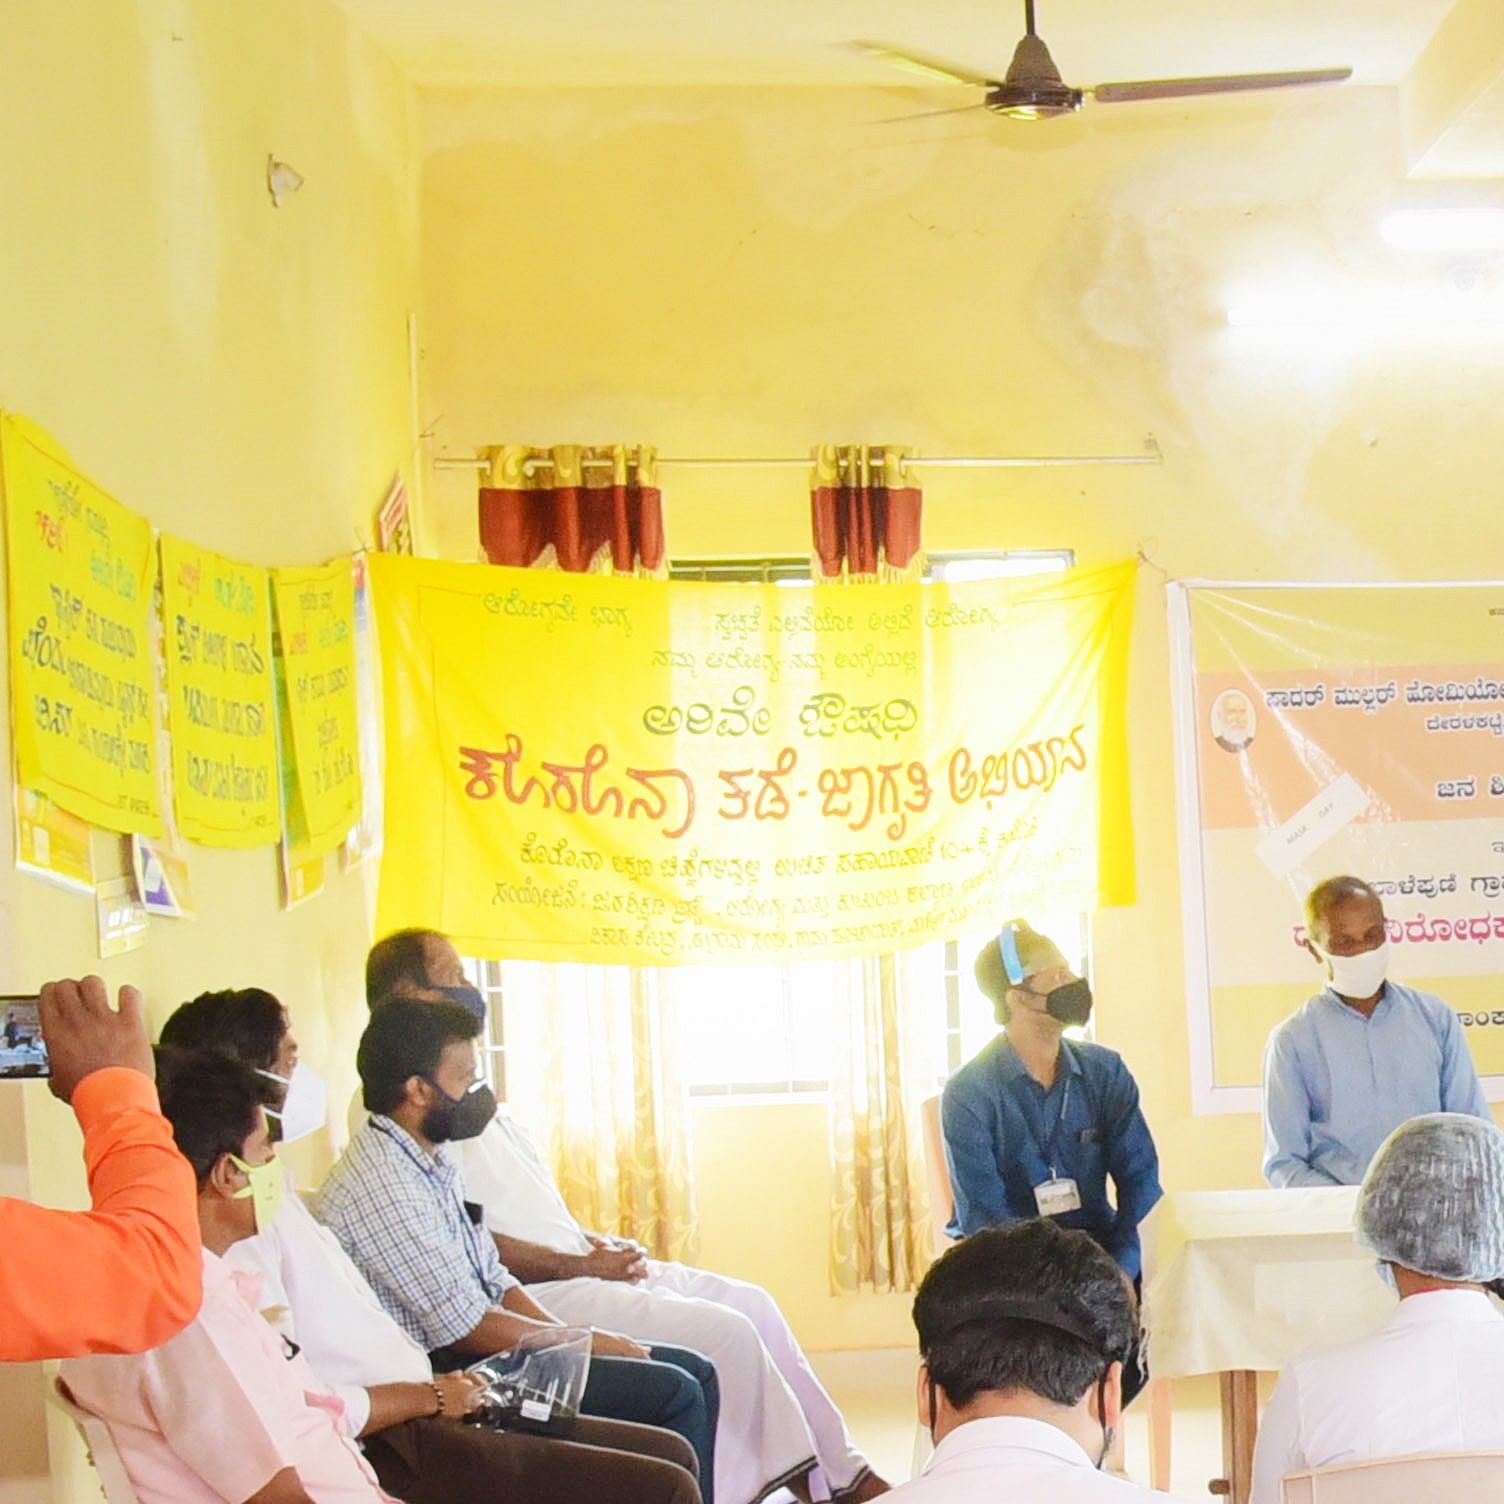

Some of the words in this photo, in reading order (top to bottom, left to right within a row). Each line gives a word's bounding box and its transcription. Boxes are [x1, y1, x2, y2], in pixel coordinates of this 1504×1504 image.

[1334, 681, 1396, 712] ಮುಲ್ಲರ್
[642, 686, 771, 736] ಅರಿವೇ
[799, 691, 918, 741] ಔಷಧಿ
[1437, 783, 1475, 798] ಜನ
